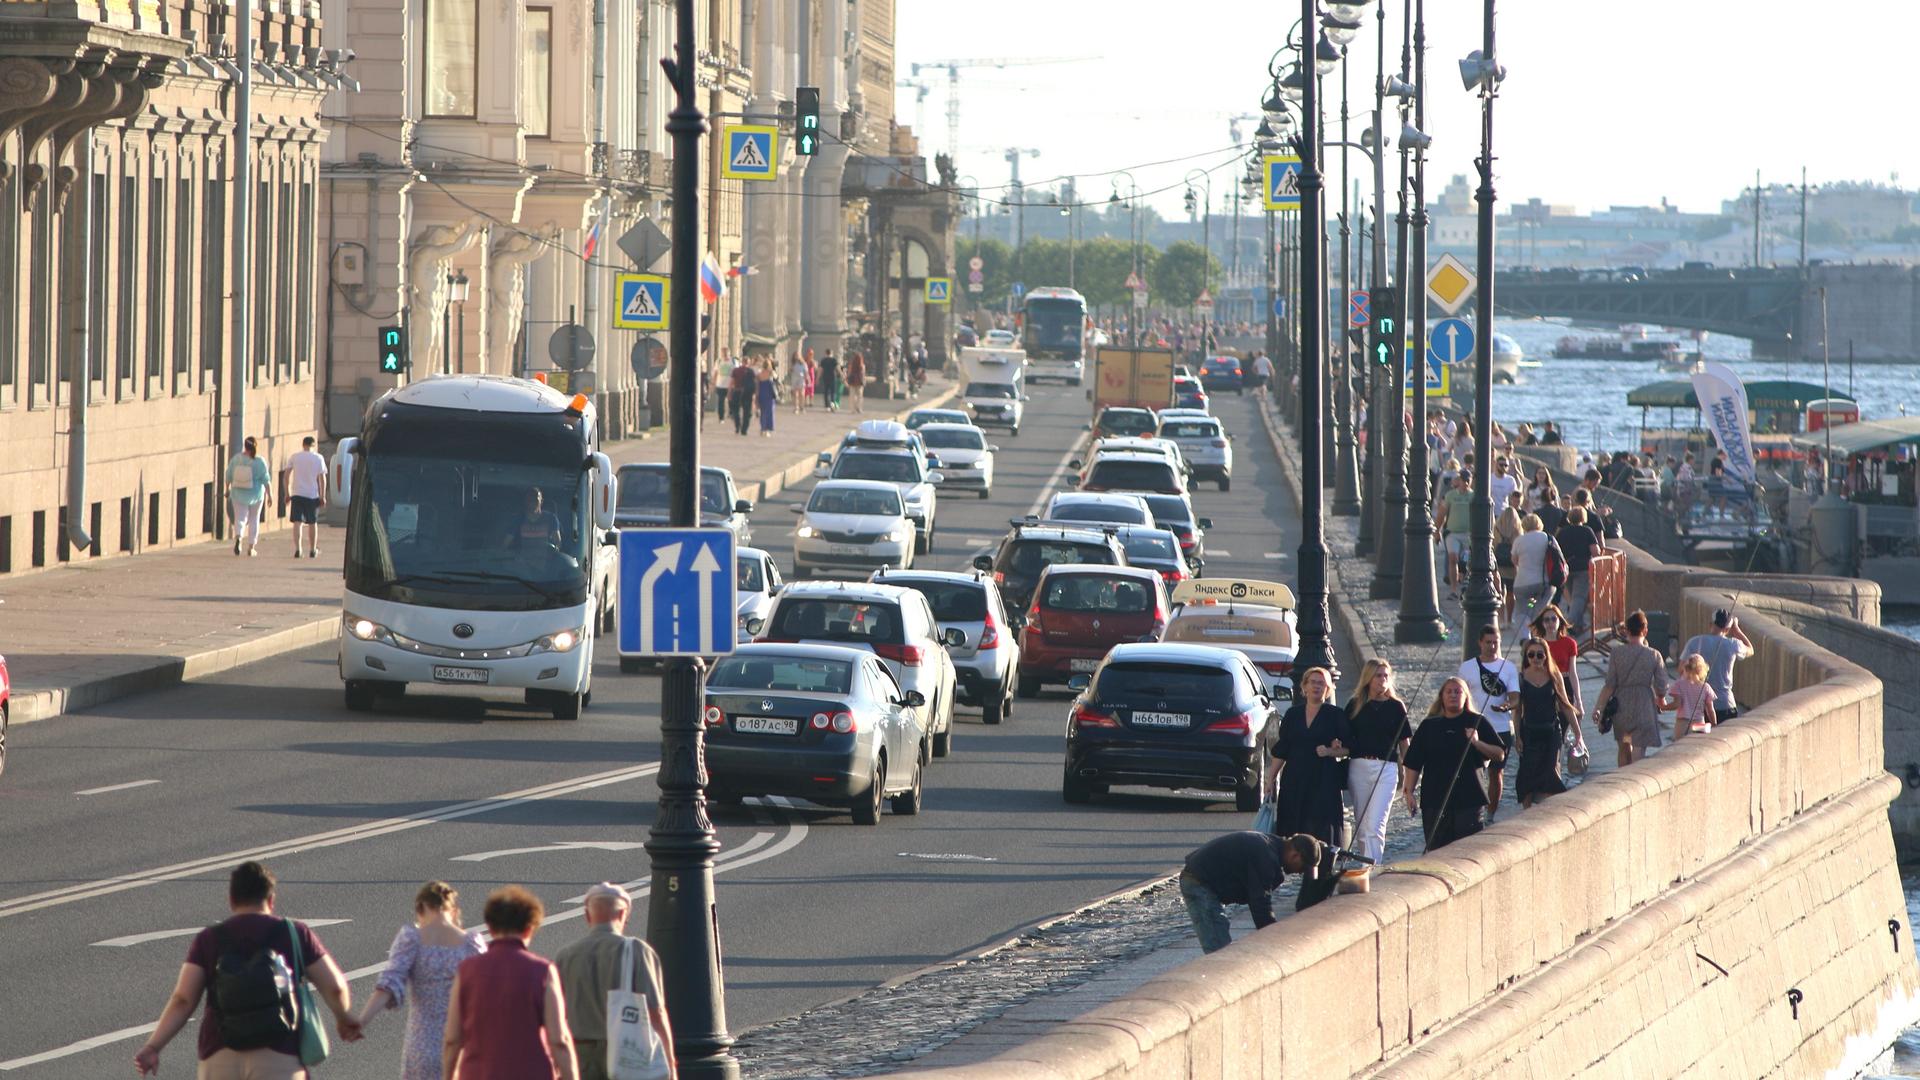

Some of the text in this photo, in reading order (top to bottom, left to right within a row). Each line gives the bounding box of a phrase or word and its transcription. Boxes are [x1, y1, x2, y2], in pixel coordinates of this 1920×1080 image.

[1194, 583, 1275, 597] Яндекс Go Такси
[669, 876, 679, 891] 5
